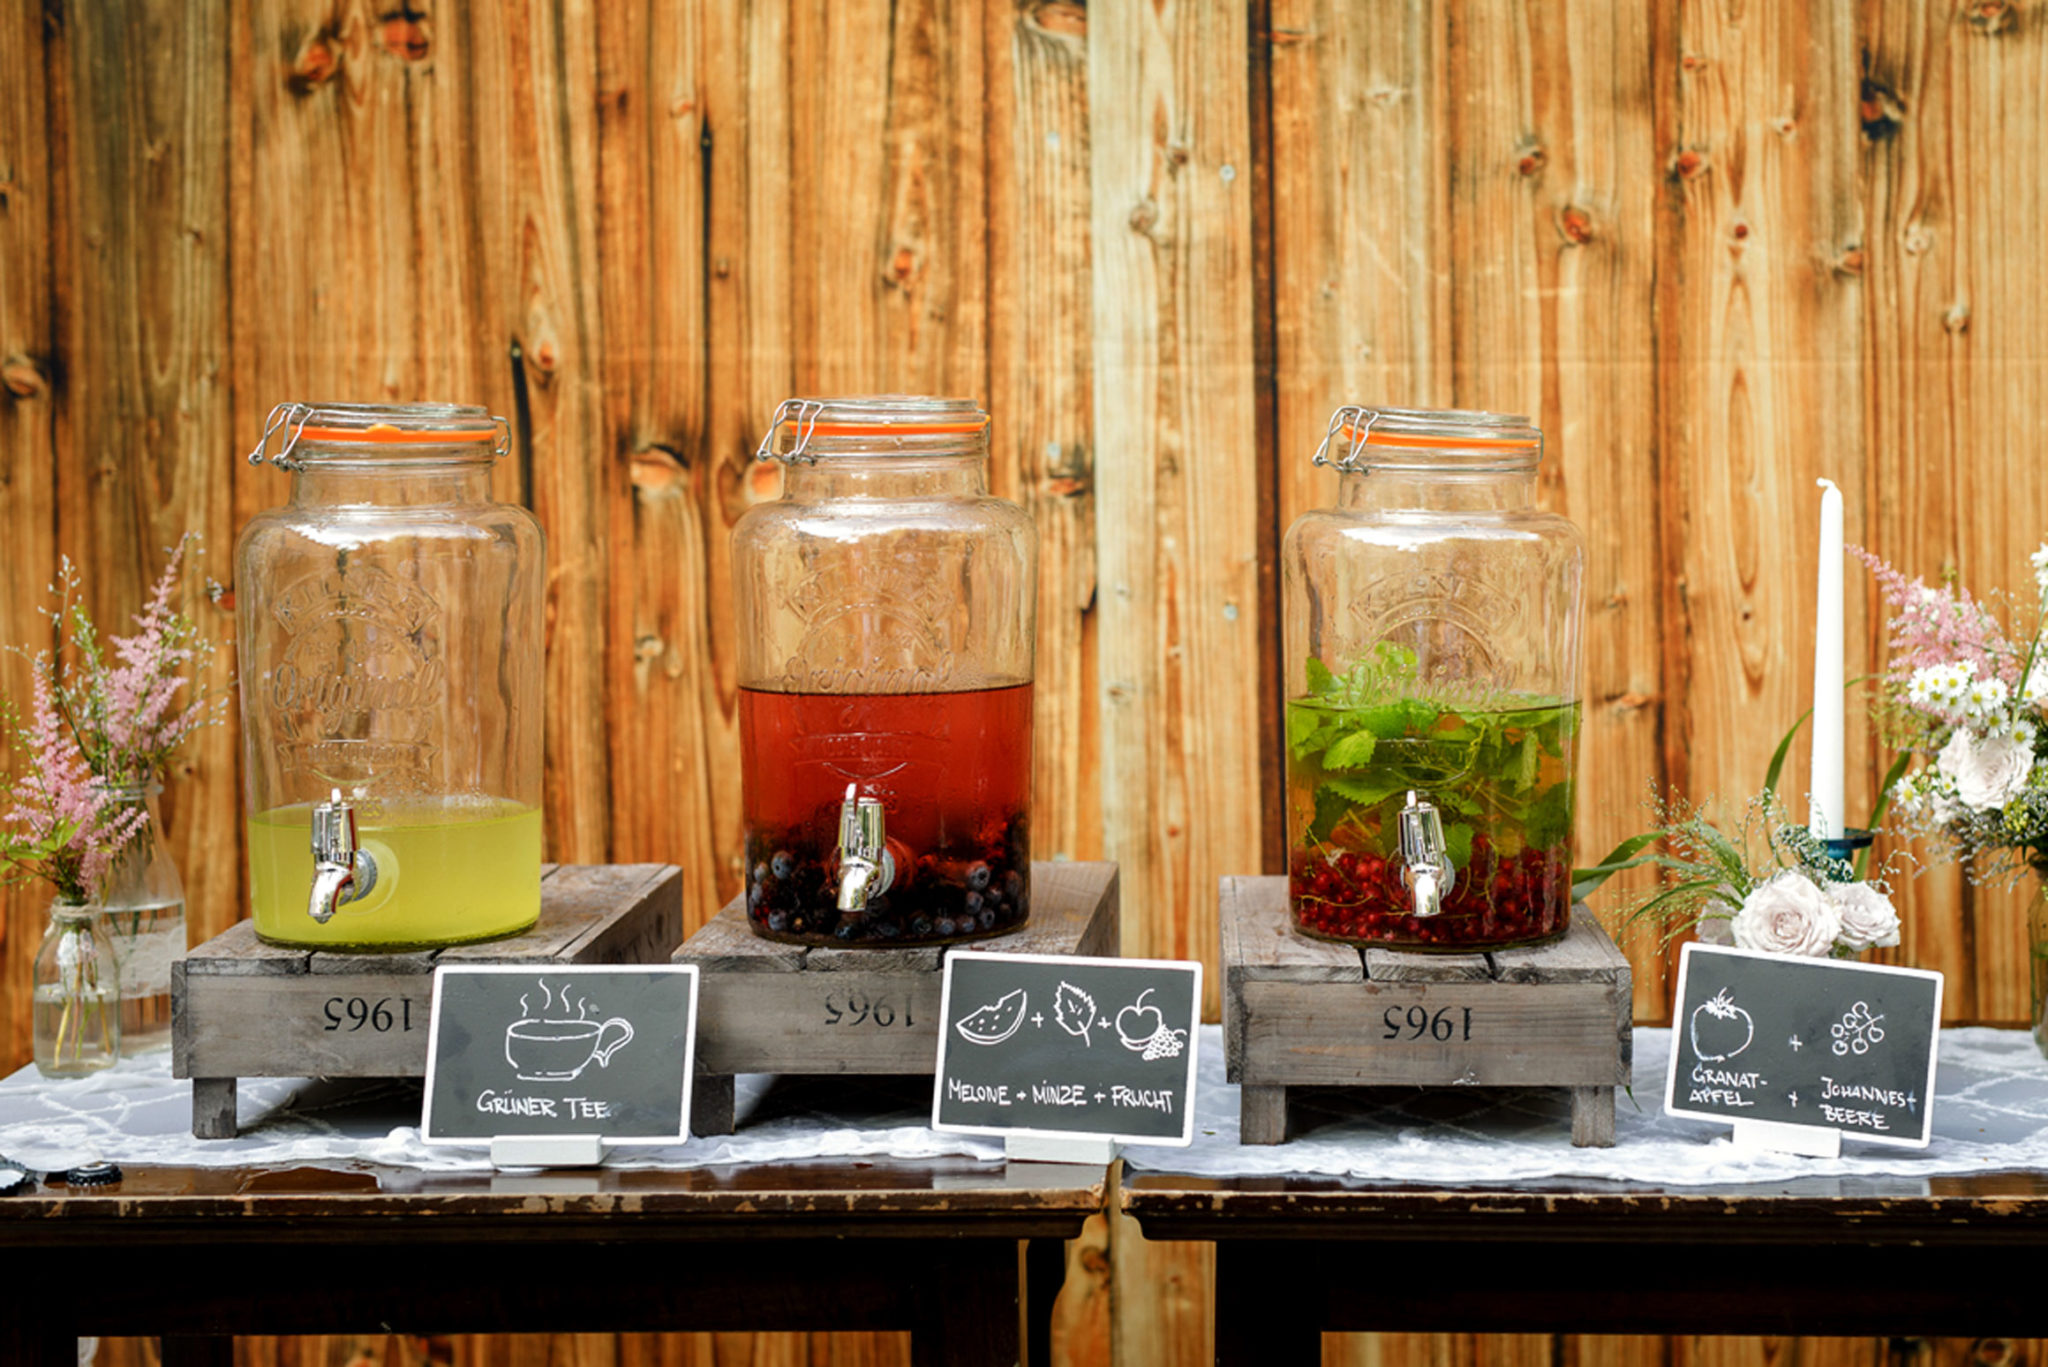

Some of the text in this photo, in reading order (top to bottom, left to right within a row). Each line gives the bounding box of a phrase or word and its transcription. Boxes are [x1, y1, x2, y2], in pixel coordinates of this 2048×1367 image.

[324, 997, 414, 1032] 1965
[1383, 1005, 1472, 1041] 1965
[476, 1089, 610, 1120] GRÜNER TEE
[949, 1078, 1011, 1105] MELONE
[1110, 1085, 1173, 1114] FRUCHT
[1819, 1104, 1890, 1130] BEERE
